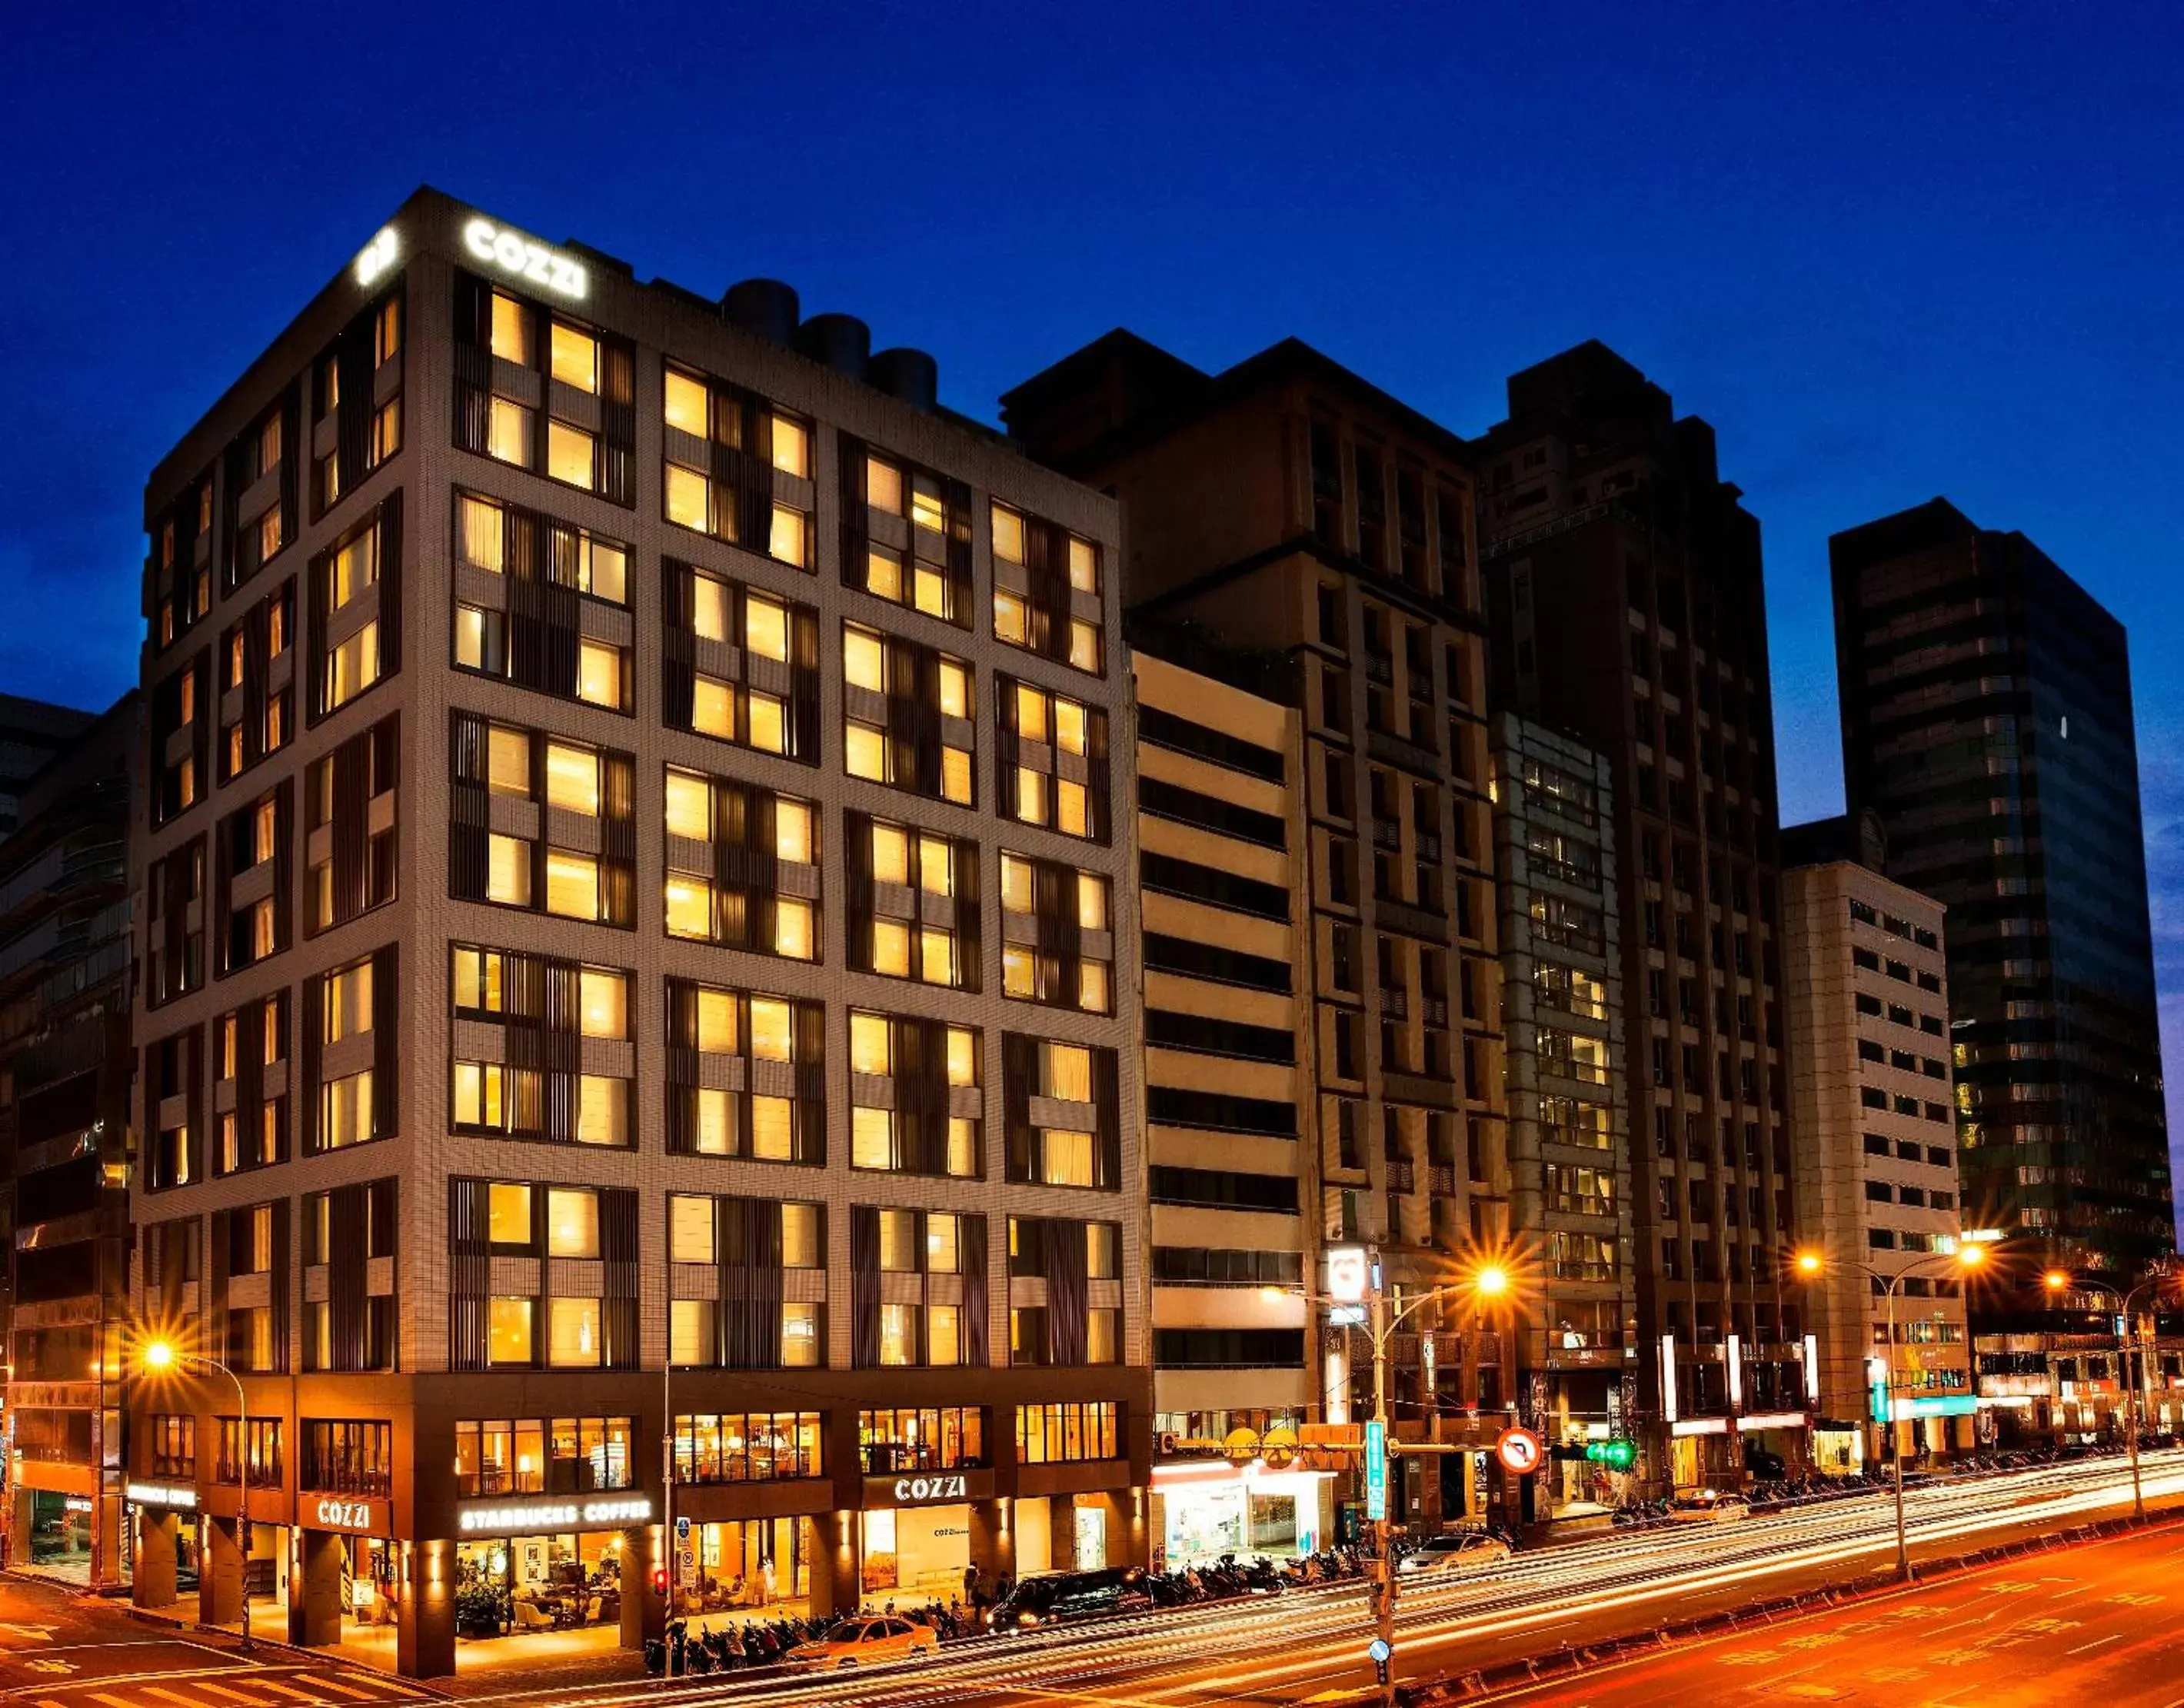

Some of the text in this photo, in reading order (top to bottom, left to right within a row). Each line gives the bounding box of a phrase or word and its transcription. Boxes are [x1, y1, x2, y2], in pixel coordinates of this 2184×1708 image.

[464, 218, 586, 299] COZZI
[895, 1476, 966, 1500] COZZI
[318, 1499, 369, 1529] COZZI
[461, 1501, 650, 1530] STARBUCKS COFFEE
